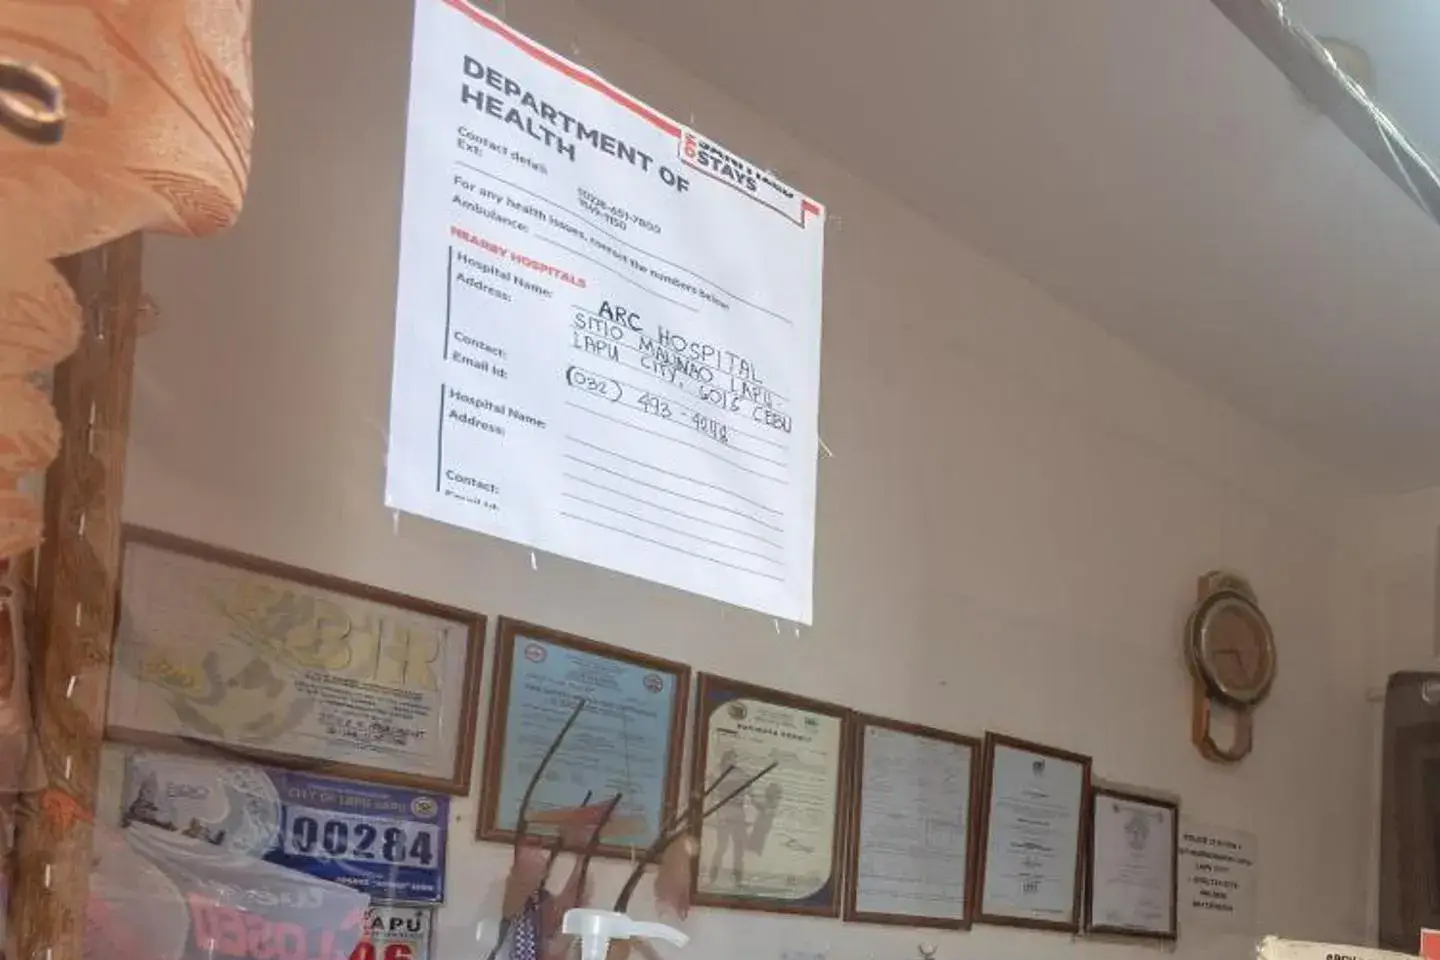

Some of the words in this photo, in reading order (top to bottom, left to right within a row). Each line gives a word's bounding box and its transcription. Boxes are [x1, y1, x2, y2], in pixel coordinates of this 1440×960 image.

[458, 126, 508, 154] Contact
[461, 83, 576, 162] HEALTH
[463, 54, 653, 172] DEPARTMENT
[659, 165, 690, 193] OF
[697, 150, 757, 191] STAYS
[454, 175, 476, 191] For
[479, 187, 503, 203] any
[506, 195, 547, 221] health
[630, 257, 648, 274] the
[650, 270, 698, 295] numbers
[450, 225, 507, 256] NEARBY
[510, 252, 587, 289] HOSPITALS
[457, 251, 511, 280] Hospital
[575, 312, 623, 341] SITIO
[598, 301, 643, 331] ARC
[658, 325, 764, 384] HOSPITAL
[452, 350, 489, 372] Email
[449, 388, 506, 415] Hospital
[752, 406, 792, 433] CEBU
[292, 816, 434, 865] 00284
[370, 915, 421, 932] APU
